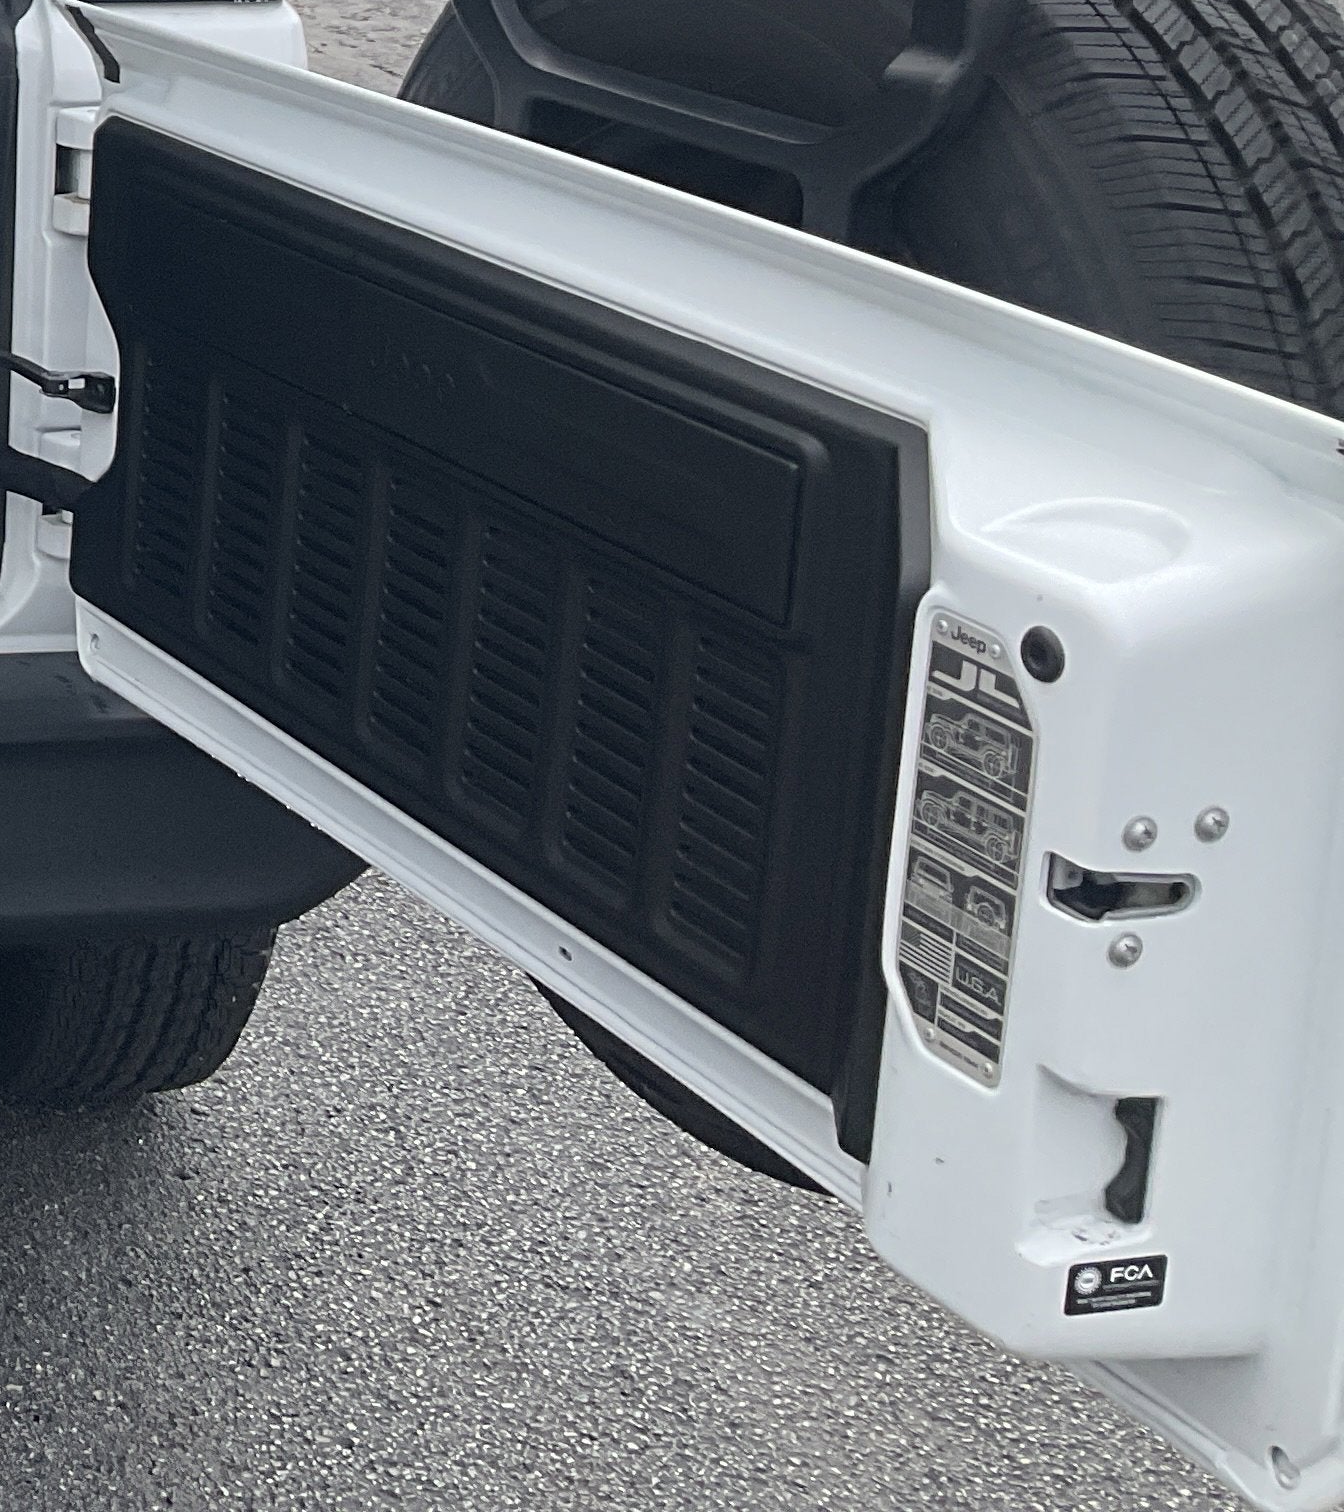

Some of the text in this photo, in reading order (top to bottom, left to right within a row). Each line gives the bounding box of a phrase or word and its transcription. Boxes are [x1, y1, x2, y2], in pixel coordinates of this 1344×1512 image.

[950, 625, 987, 655] Jeep
[931, 659, 1021, 709] JL
[1109, 1263, 1154, 1283] FCA
